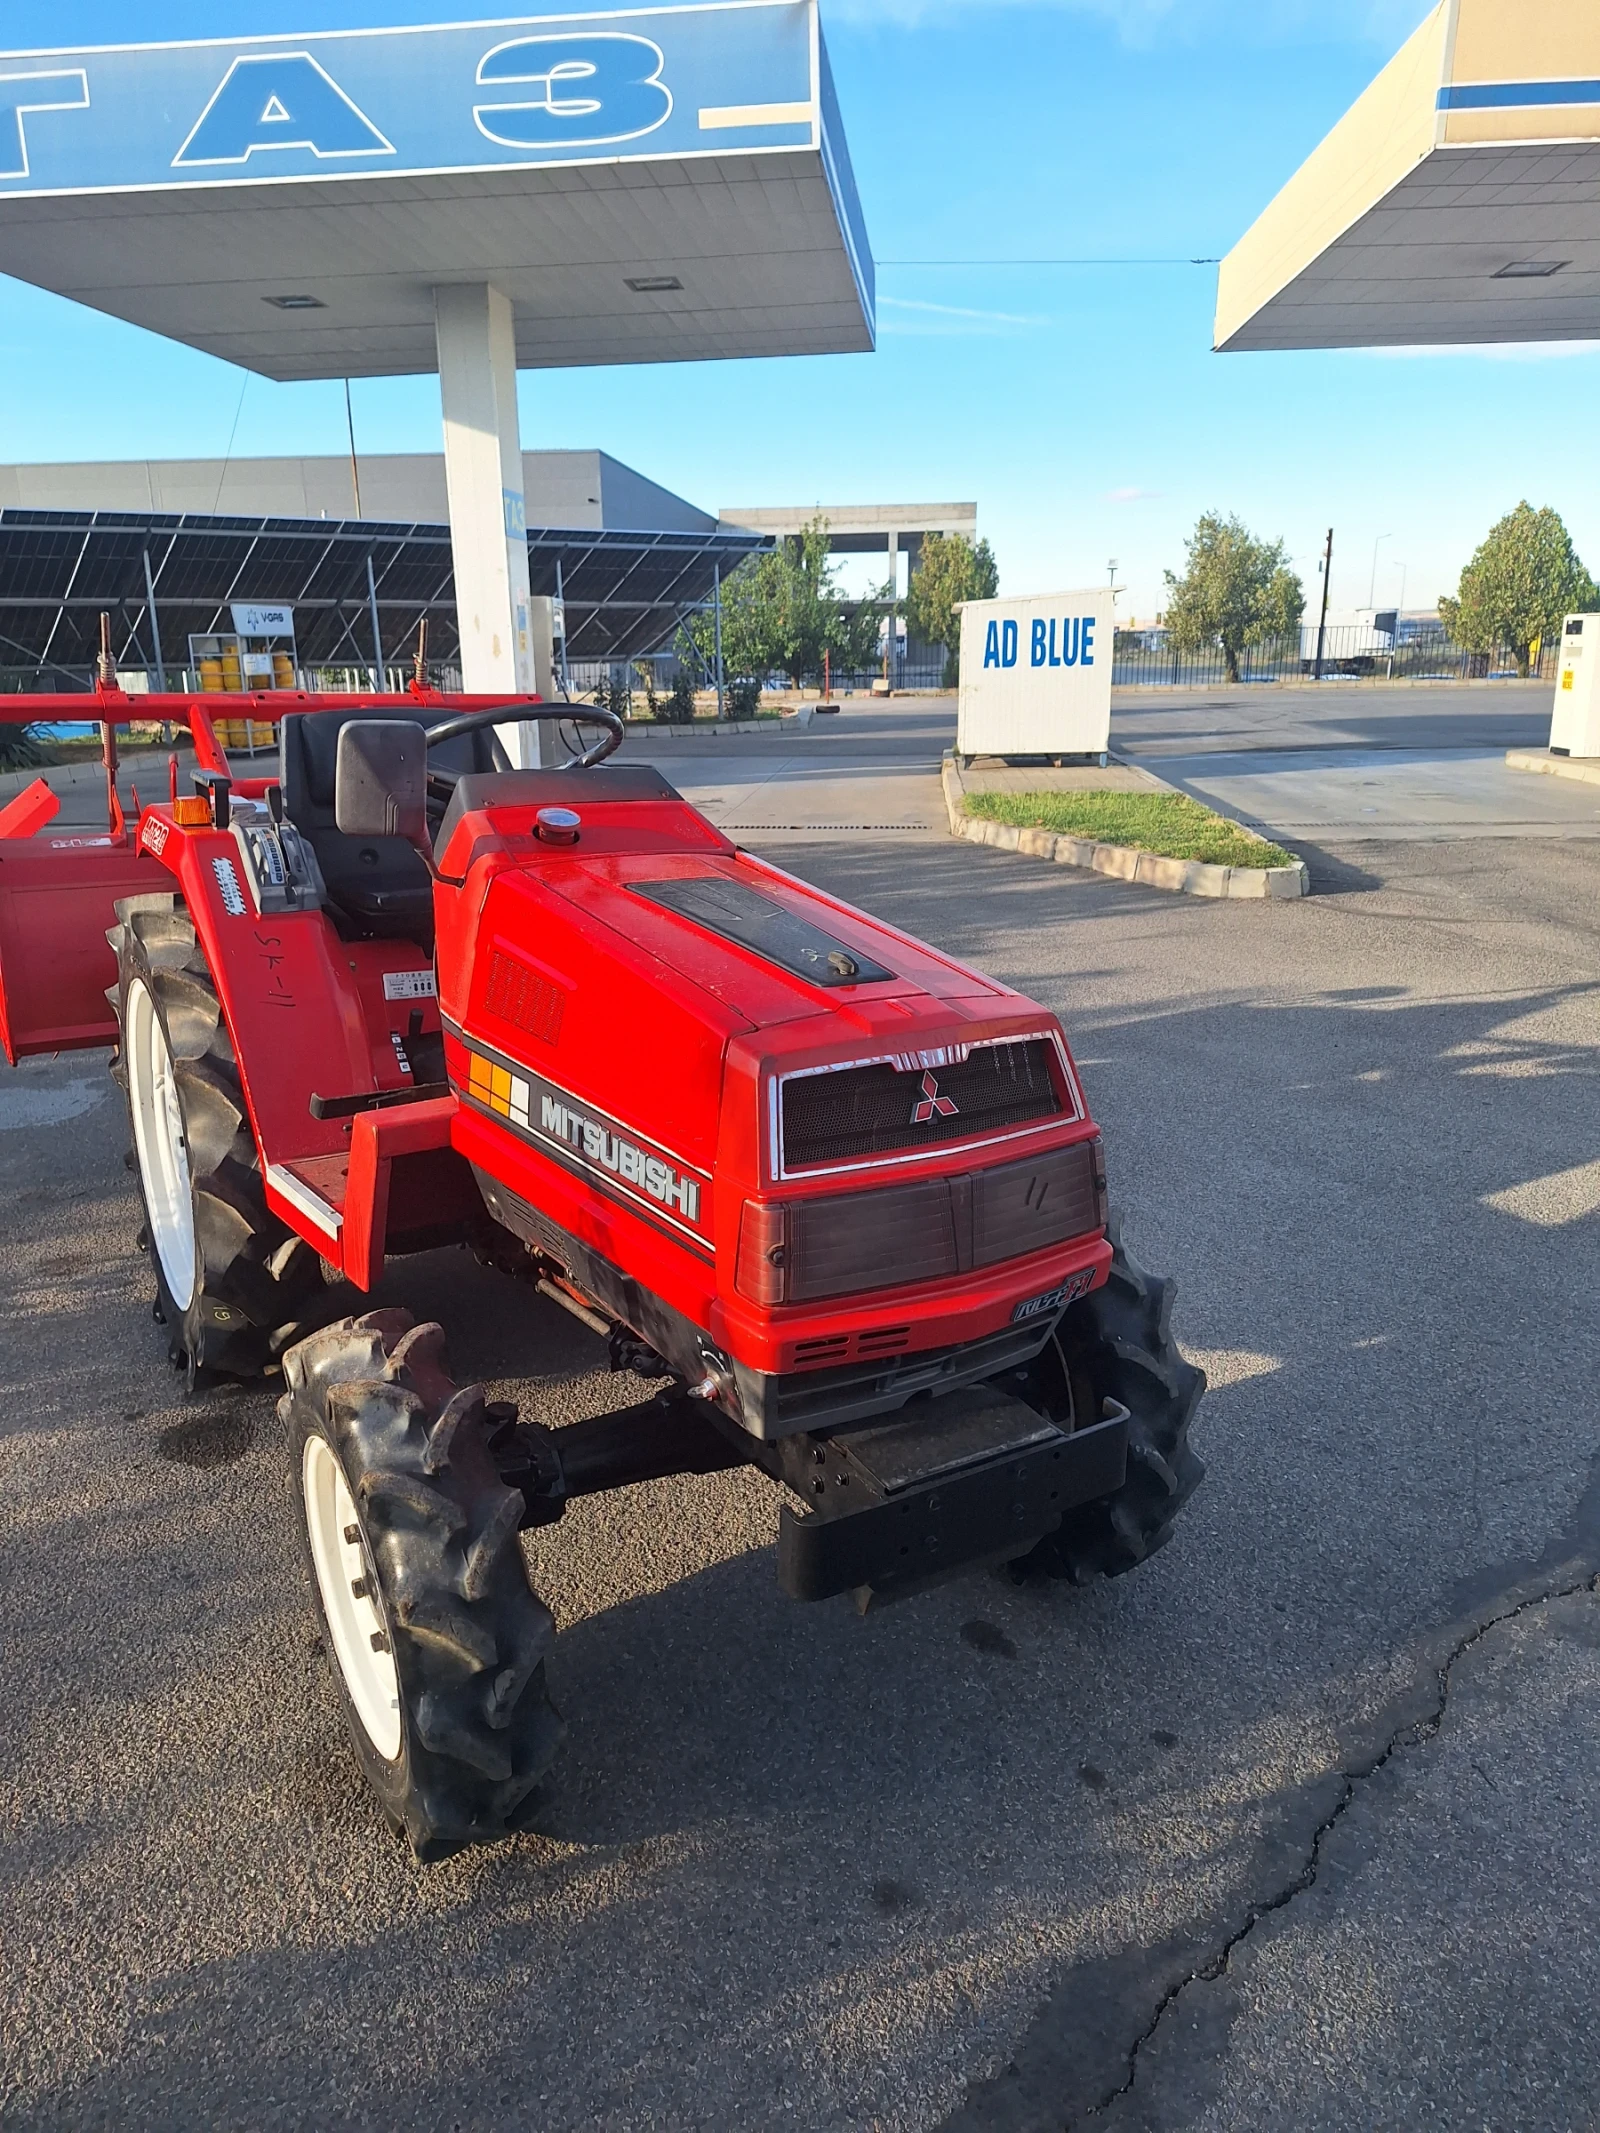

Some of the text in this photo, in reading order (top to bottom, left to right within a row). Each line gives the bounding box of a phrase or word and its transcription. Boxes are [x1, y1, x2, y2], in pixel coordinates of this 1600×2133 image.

[983, 617, 1096, 668] AD BLUE
[541, 1093, 700, 1223] MITSUBISHI
